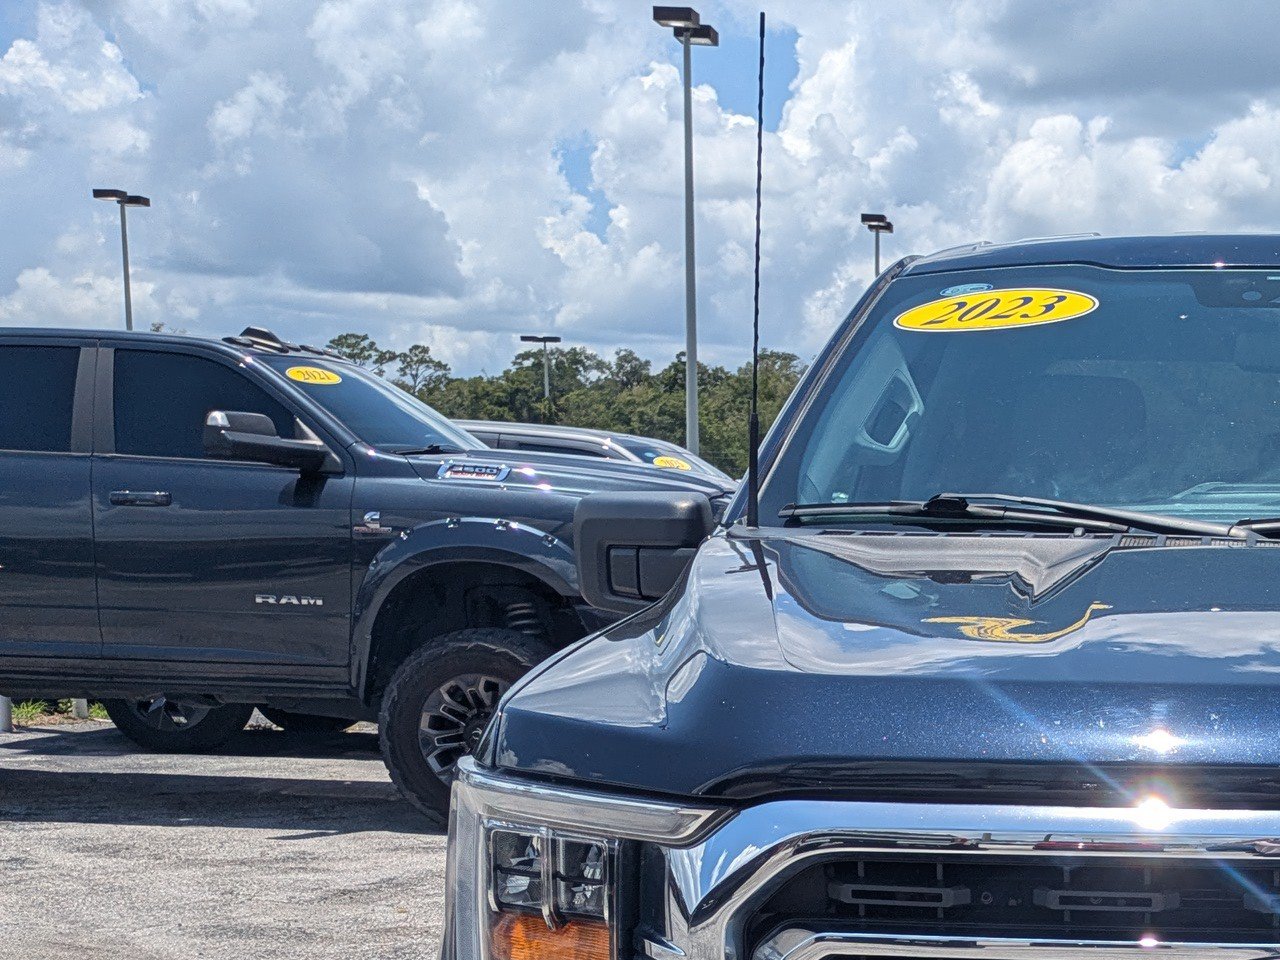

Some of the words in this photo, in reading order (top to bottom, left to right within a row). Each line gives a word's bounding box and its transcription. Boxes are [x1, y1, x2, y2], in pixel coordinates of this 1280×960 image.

[919, 295, 1068, 326] 2023
[296, 370, 332, 381] 2021
[255, 594, 324, 606] RAM
